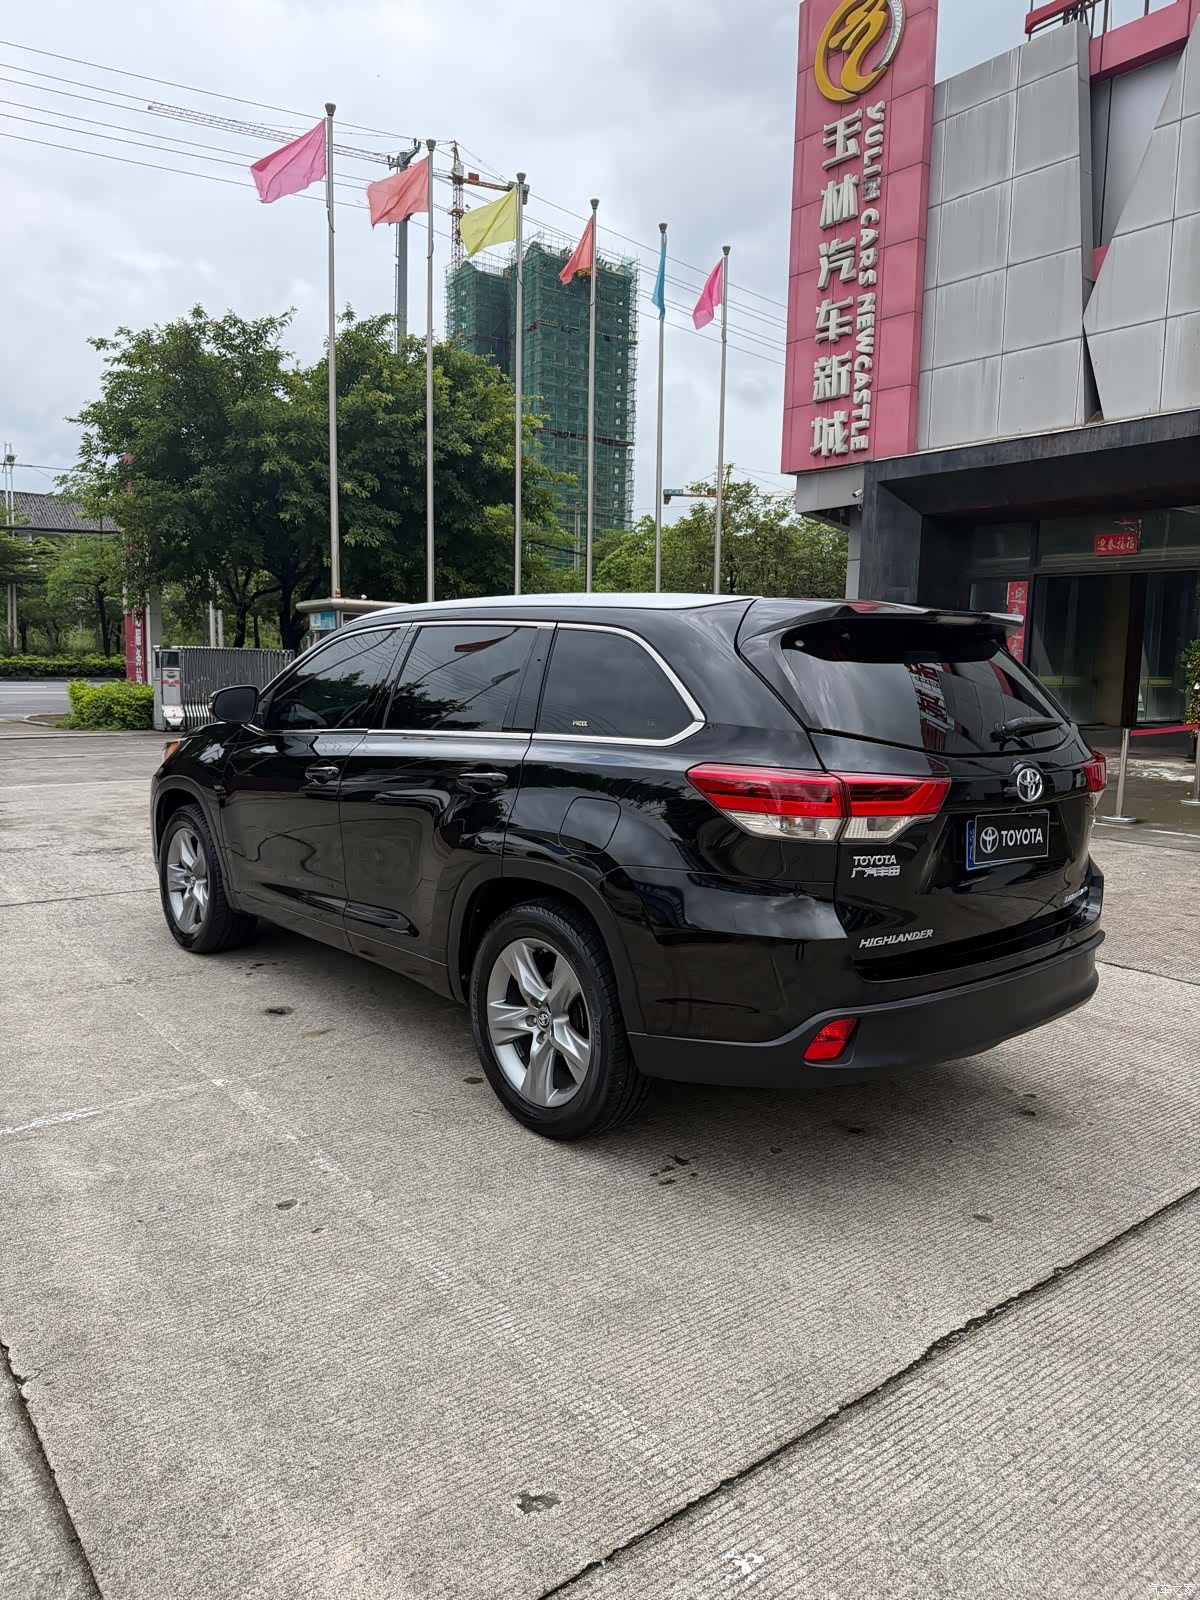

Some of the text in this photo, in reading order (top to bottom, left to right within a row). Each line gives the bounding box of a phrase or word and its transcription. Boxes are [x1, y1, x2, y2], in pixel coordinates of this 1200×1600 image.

[861, 100, 886, 203] YULIN
[857, 207, 880, 288] CARS
[810, 107, 862, 457] 玉林汽车新城
[853, 855, 897, 866] TOYOTA
[1000, 827, 1043, 847] TOYOTA
[859, 928, 934, 949] HIGHLANDER
